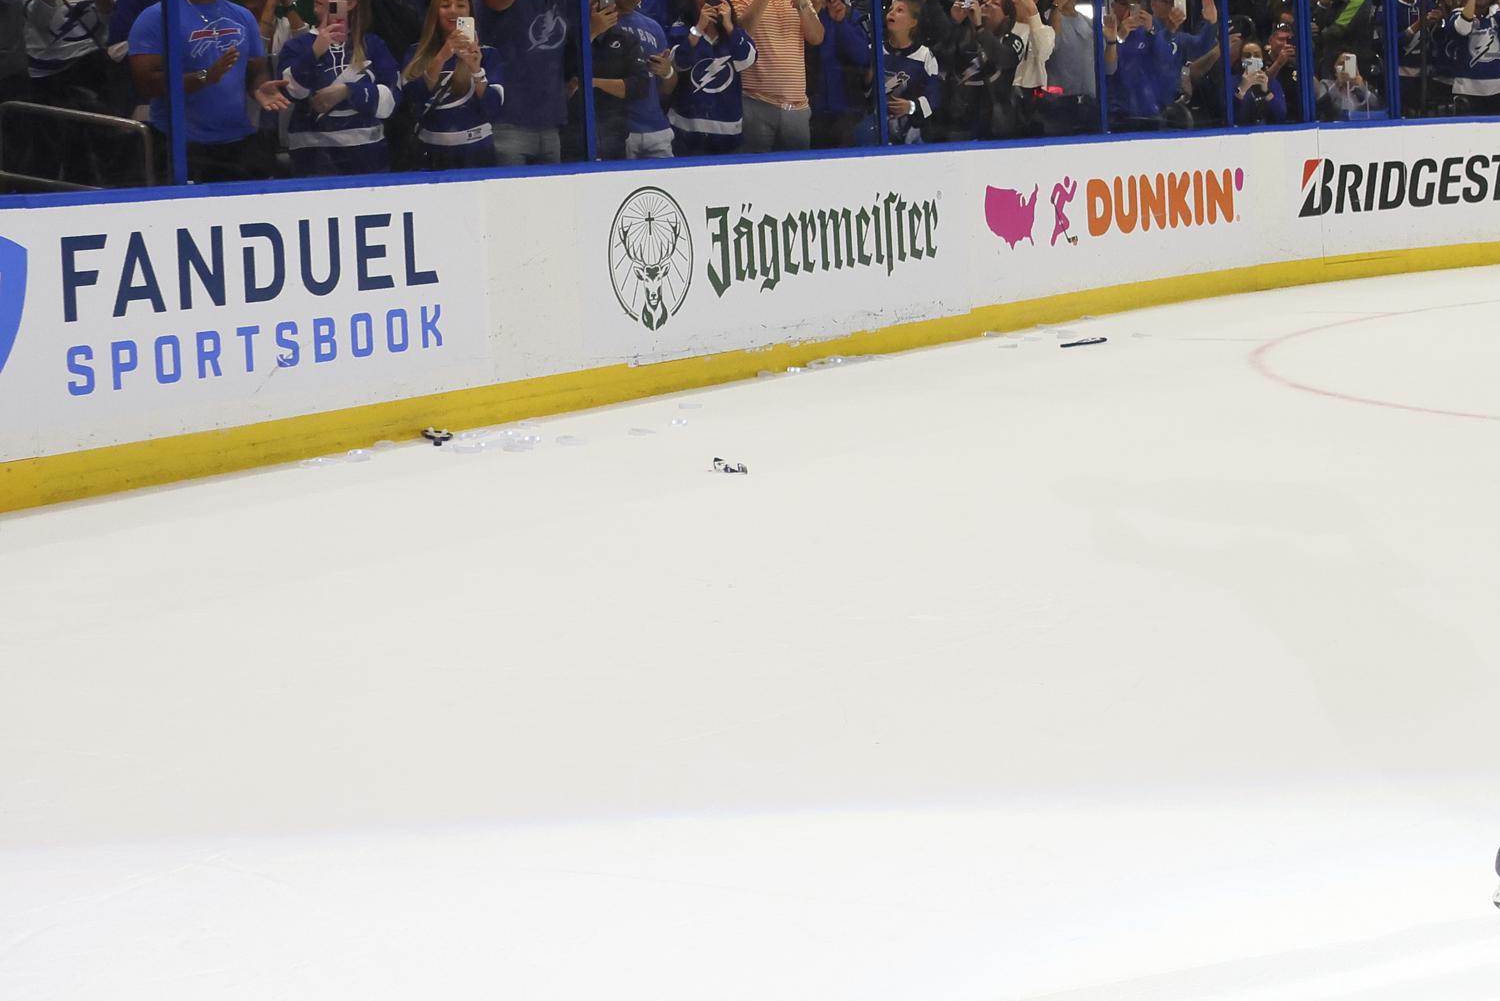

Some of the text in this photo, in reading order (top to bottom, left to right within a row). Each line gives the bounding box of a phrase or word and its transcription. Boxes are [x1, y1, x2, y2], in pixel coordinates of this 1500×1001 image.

[1086, 167, 1244, 237] DUNKIN'
[61, 211, 439, 323] FANDUEL
[67, 304, 443, 396] SPORTSBOOK
